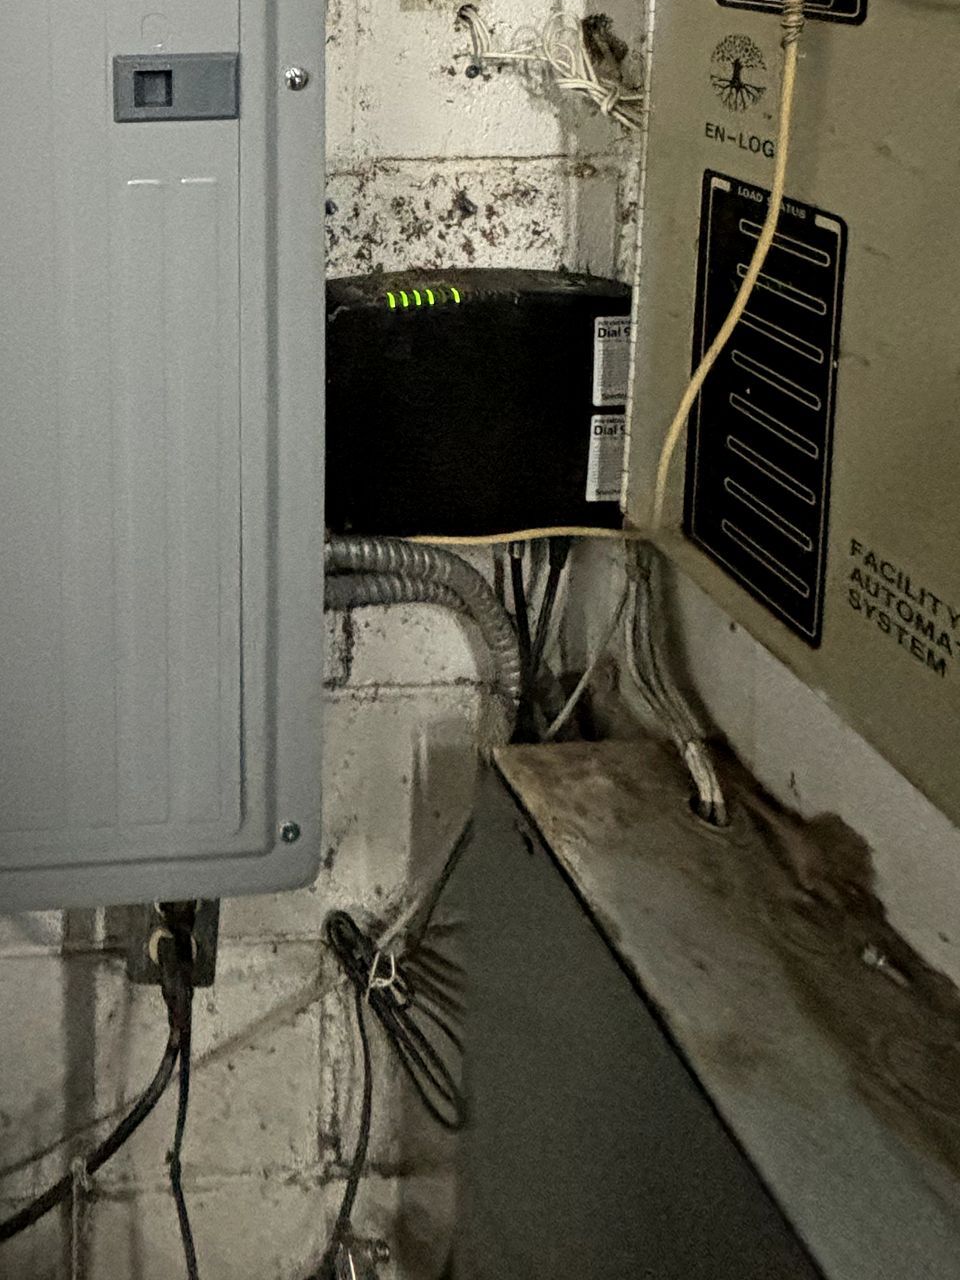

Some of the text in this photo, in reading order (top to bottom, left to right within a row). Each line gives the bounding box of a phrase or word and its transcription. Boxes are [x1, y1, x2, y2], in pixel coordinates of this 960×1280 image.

[704, 122, 775, 159] EN-LOG
[737, 185, 764, 204] LOAD
[597, 326, 621, 338] Dial
[594, 424, 617, 436] Dial
[849, 538, 960, 630] FACILITY
[848, 567, 960, 659] AUTOMA
[847, 588, 947, 679] SYSTEM
